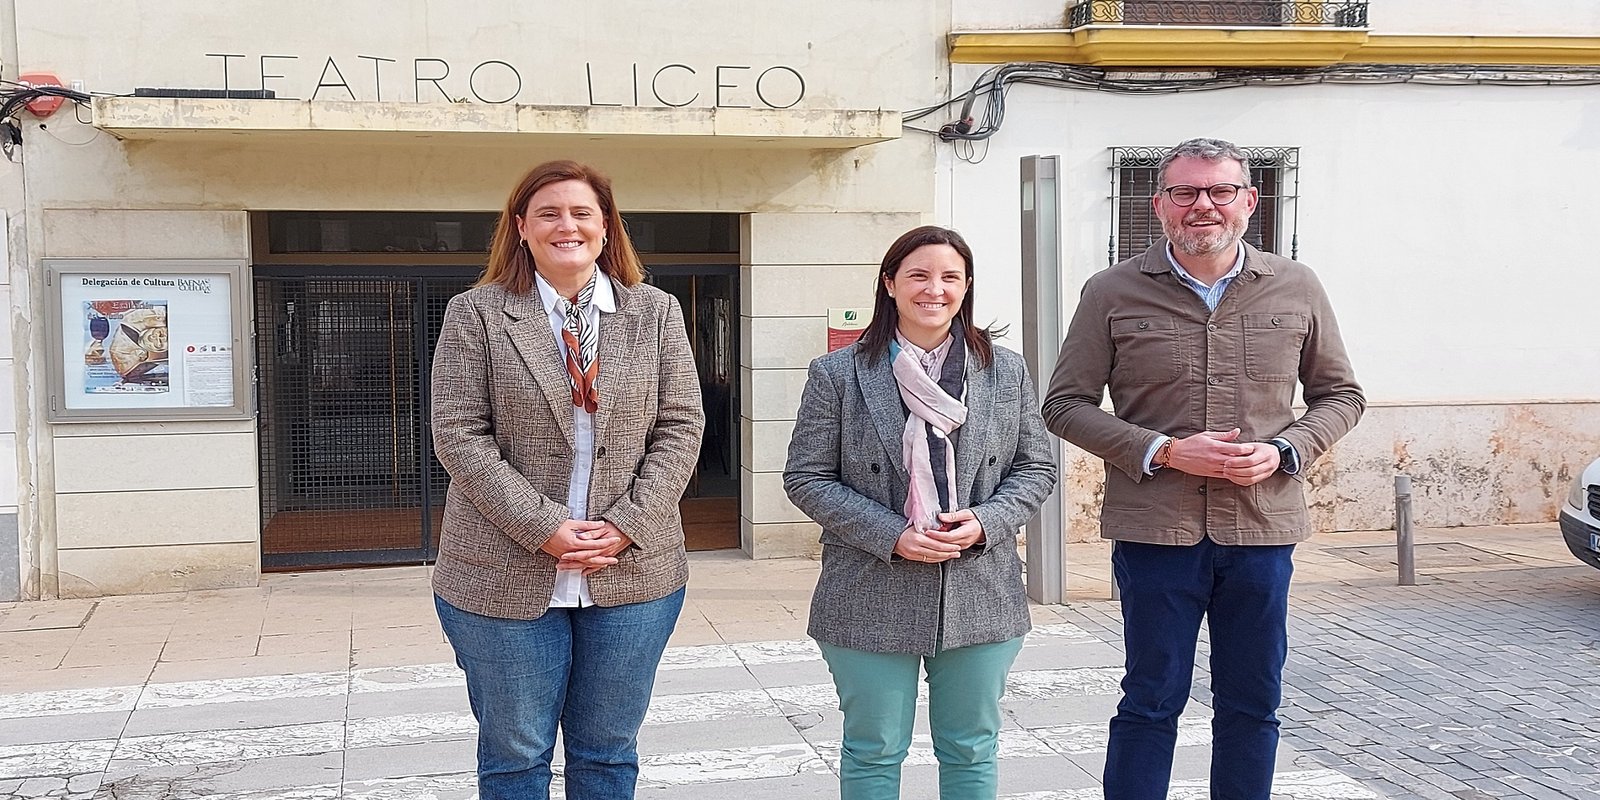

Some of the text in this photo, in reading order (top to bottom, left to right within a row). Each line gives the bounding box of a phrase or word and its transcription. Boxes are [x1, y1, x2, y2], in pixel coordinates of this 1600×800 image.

[205, 53, 806, 109] TEATRO LICEO
[82, 277, 175, 288] Delegación de Cultura
